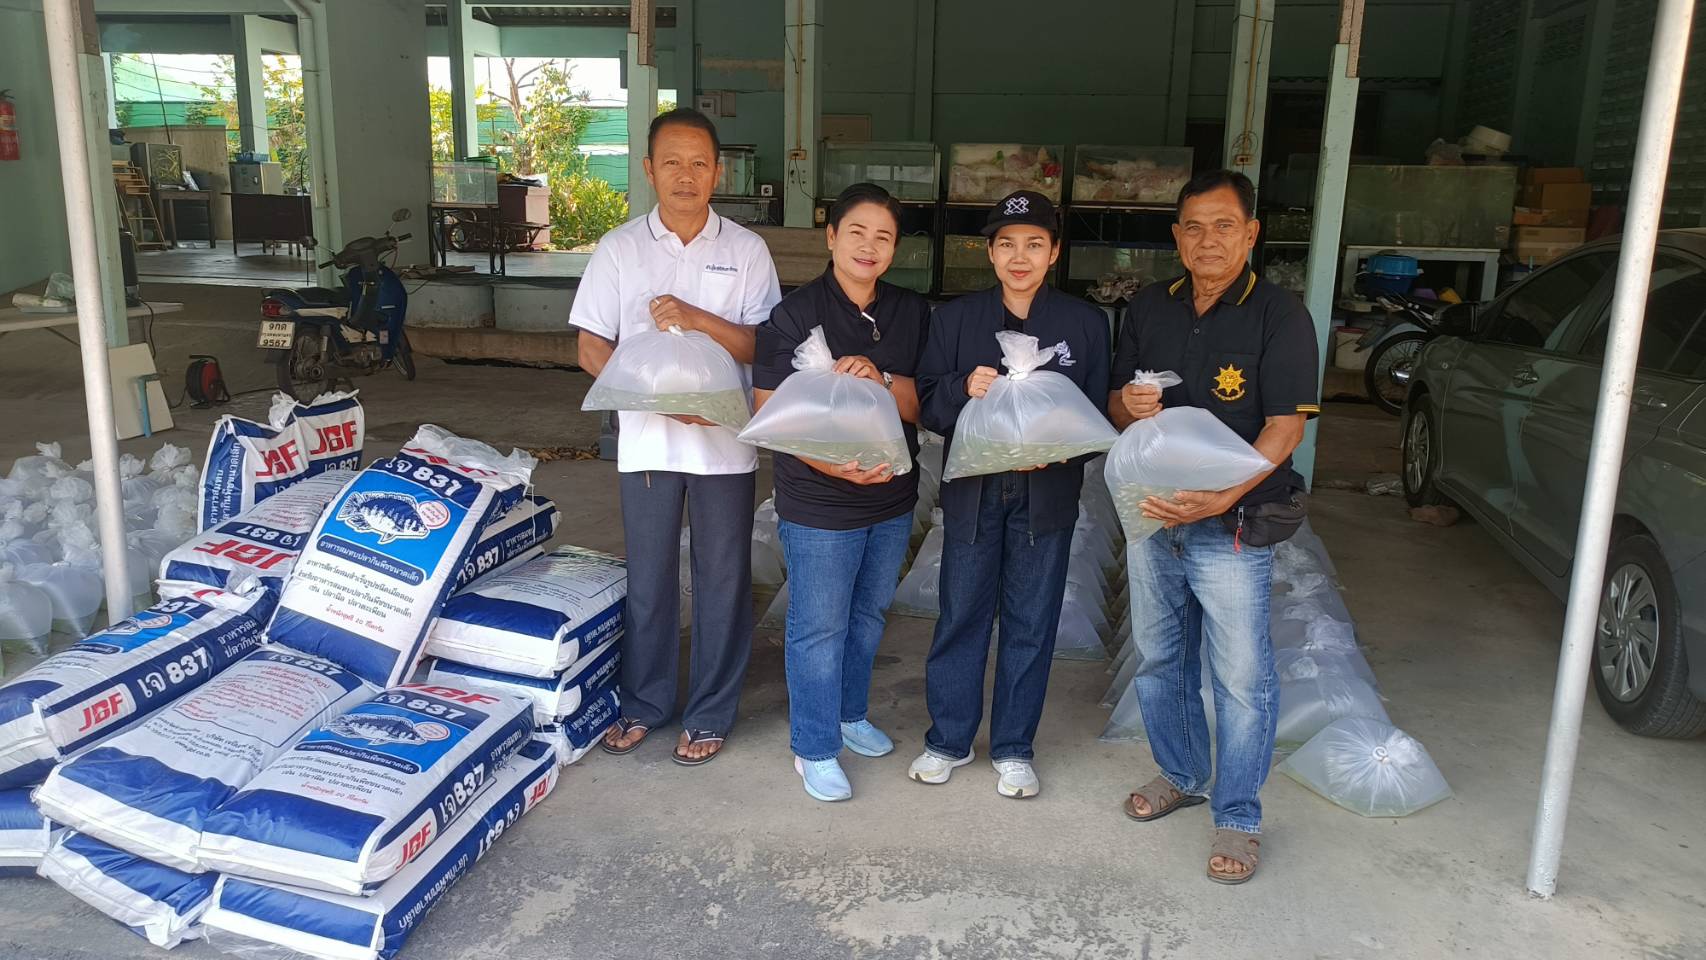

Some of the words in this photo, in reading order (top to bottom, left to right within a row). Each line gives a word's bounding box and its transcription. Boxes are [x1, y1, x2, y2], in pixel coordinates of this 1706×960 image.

[262, 339, 287, 348] 9567
[310, 420, 358, 455] JBF
[385, 457, 413, 473] เจ
[413, 467, 464, 497] 837
[236, 525, 280, 542] 837
[476, 545, 499, 574] 837
[217, 619, 257, 646] อาหารสม
[295, 660, 342, 676] 837
[79, 691, 124, 732] JBF
[137, 671, 166, 699] เจ
[165, 646, 210, 685] 837
[407, 699, 467, 720] 837
[396, 821, 432, 870] JBF
[439, 794, 456, 824] เจ
[453, 762, 485, 806] 837
